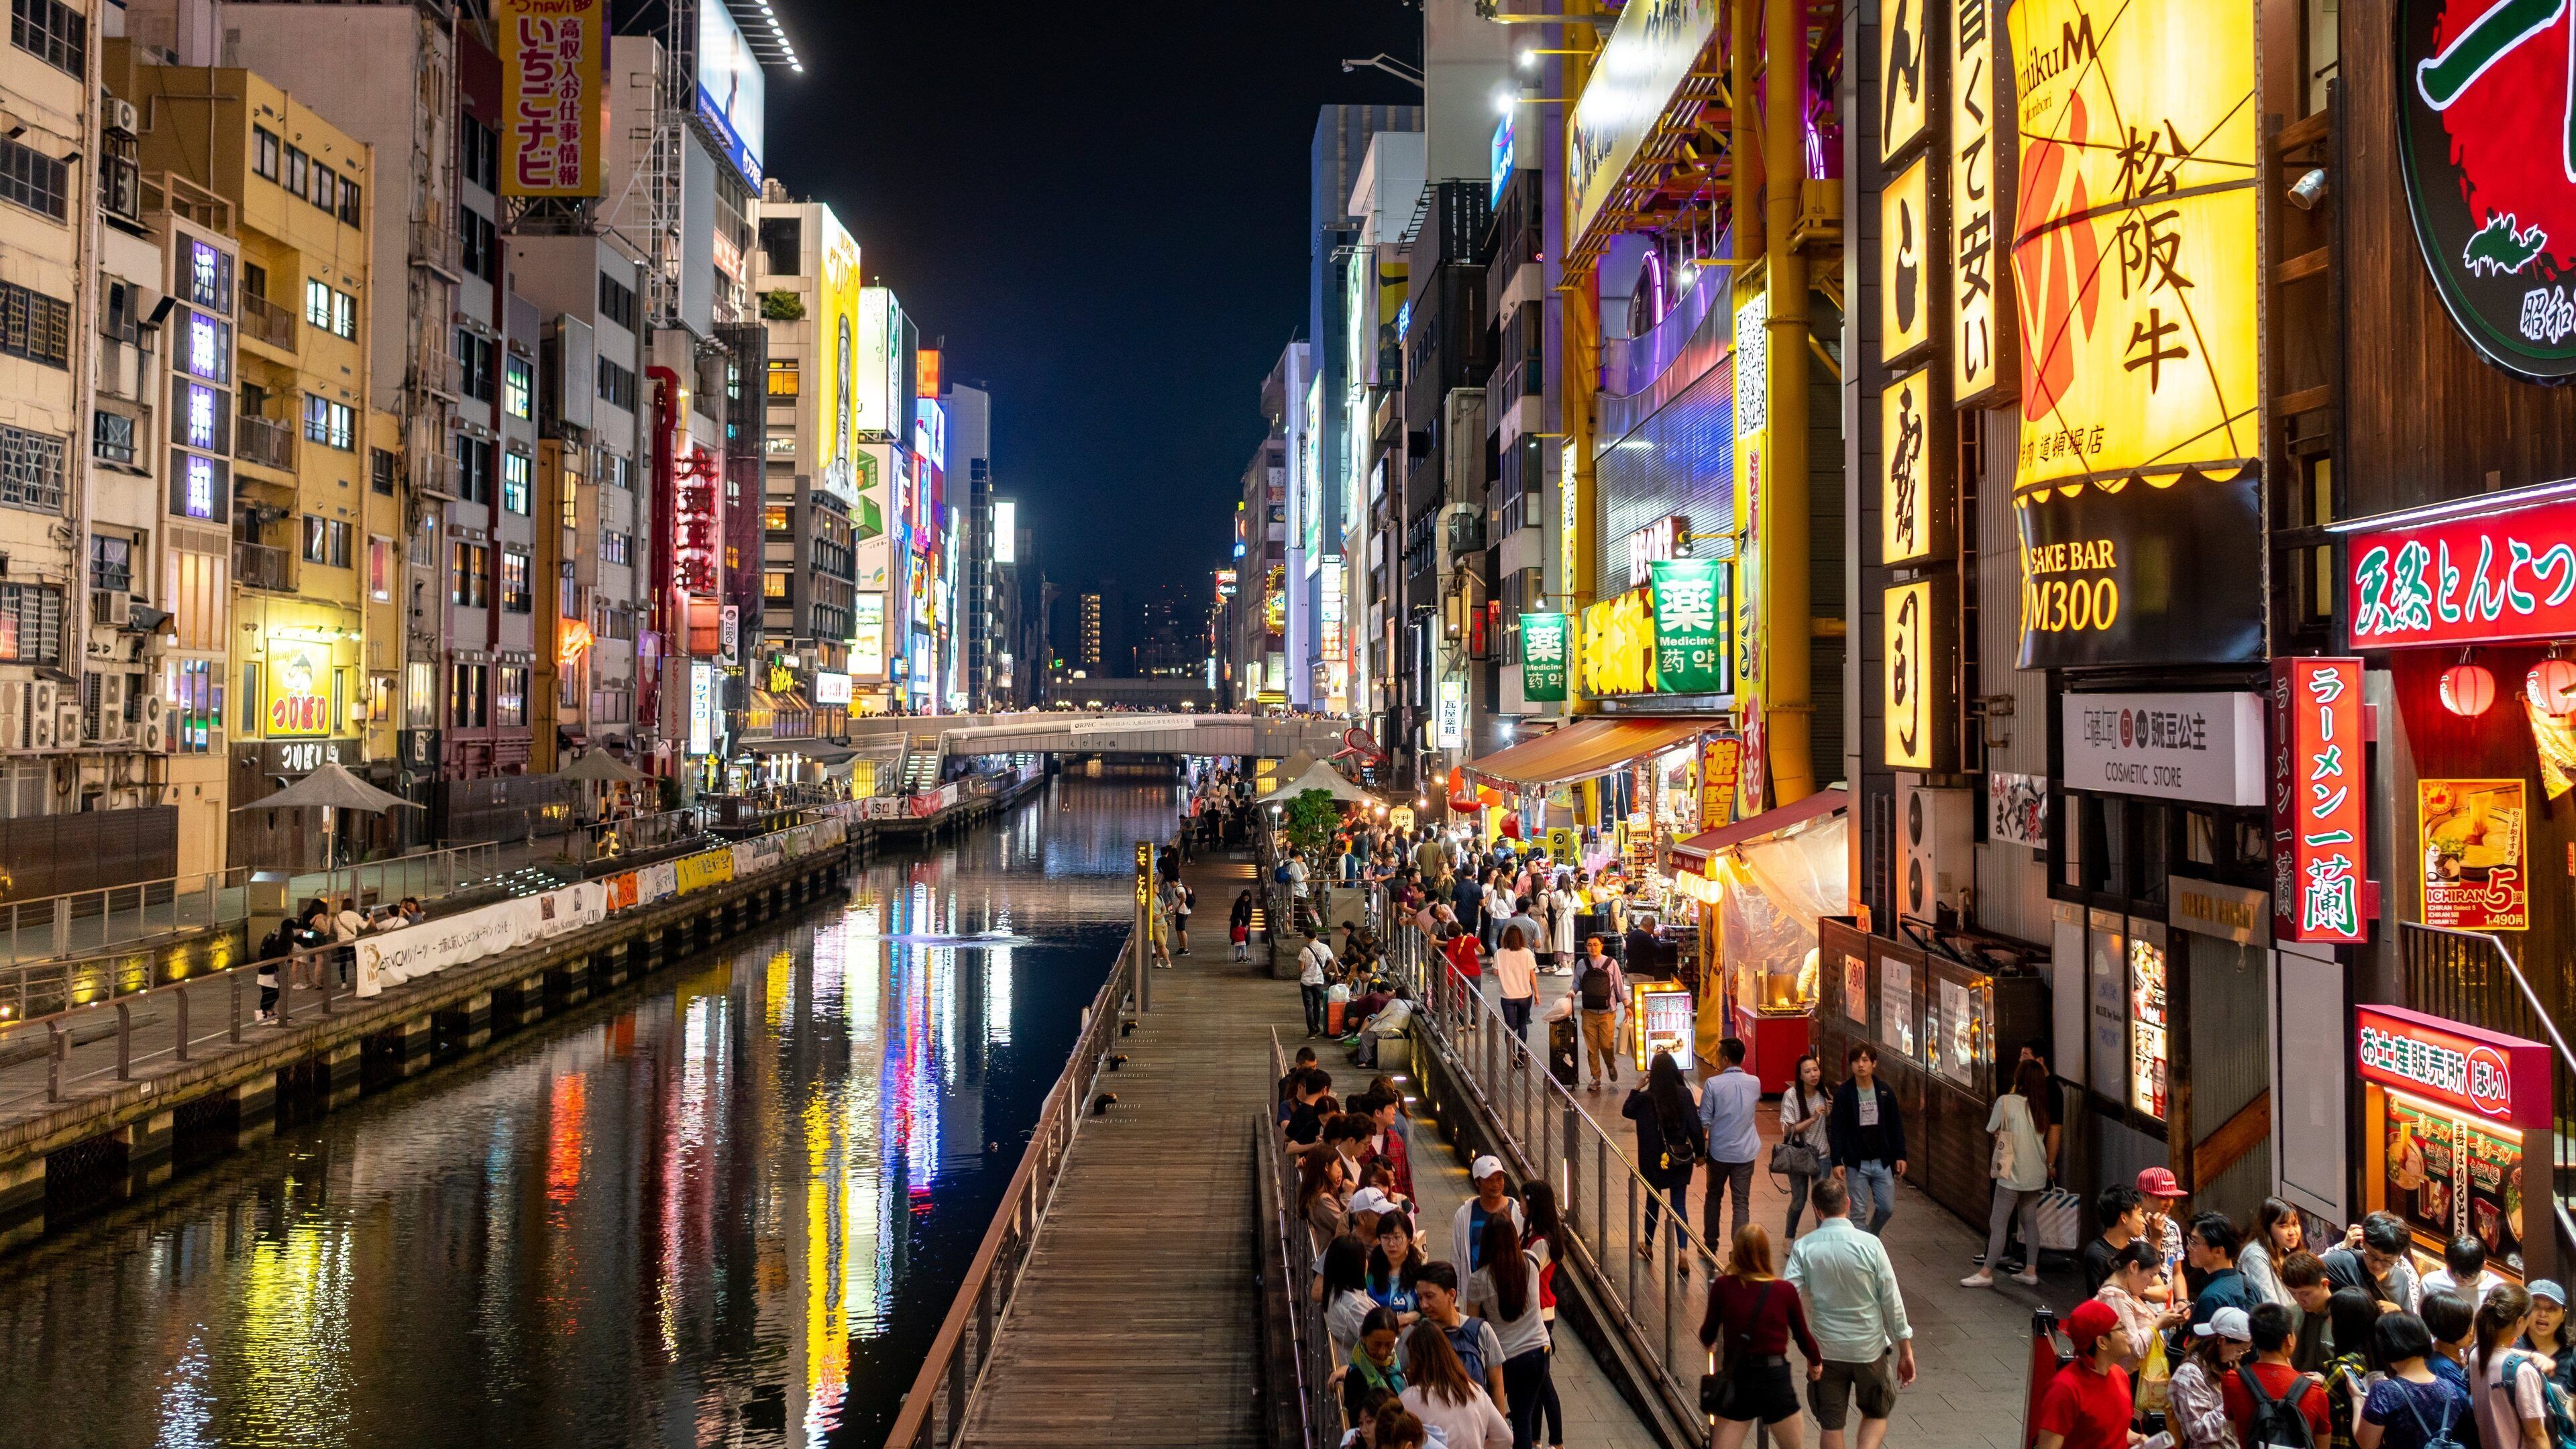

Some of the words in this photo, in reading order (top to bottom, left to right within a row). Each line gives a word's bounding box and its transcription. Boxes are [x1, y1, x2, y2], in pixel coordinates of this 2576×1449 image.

[519, 17, 554, 186] いちごナビ
[559, 19, 581, 186] 高収入お仕事情報
[2110, 119, 2195, 394] 松阪牛
[2520, 285, 2576, 343] 昭和
[2039, 425, 2105, 463] 道頓堀店
[2031, 543, 2067, 575] SAKE
[2070, 539, 2116, 571] BAR
[2355, 535, 2576, 636] 天然とんこつ
[1659, 579, 1714, 632] 薬
[2030, 578, 2119, 633] M300
[1526, 625, 1562, 661] 薬
[1660, 636, 1715, 647] Medicine
[1662, 649, 1684, 673] 药
[1693, 649, 1715, 674] 약
[1527, 672, 1543, 689] 药
[1548, 672, 1564, 689] 약
[272, 696, 326, 730] つりぼり
[1444, 700, 1456, 735] 瓦屋薬粧
[2151, 711, 2206, 751] 豌豆公主
[282, 743, 322, 771] つりぼり
[1070, 739, 1116, 748] えびす橋
[1702, 741, 1738, 830] 遊覧
[2105, 761, 2148, 785] COSMETIC
[2153, 765, 2182, 788] STORE
[2274, 676, 2295, 924] ラーメン一蘭
[2305, 666, 2358, 937] ラーメン一蘭
[2426, 888, 2487, 904] ICHIRAN
[2359, 1024, 2466, 1095] お土産販売所
[2470, 1058, 2508, 1101] ばい
[2410, 1112, 2453, 1143] 一蘭ラーメン
[2469, 1132, 2513, 1165] 一蘭ラーメン
